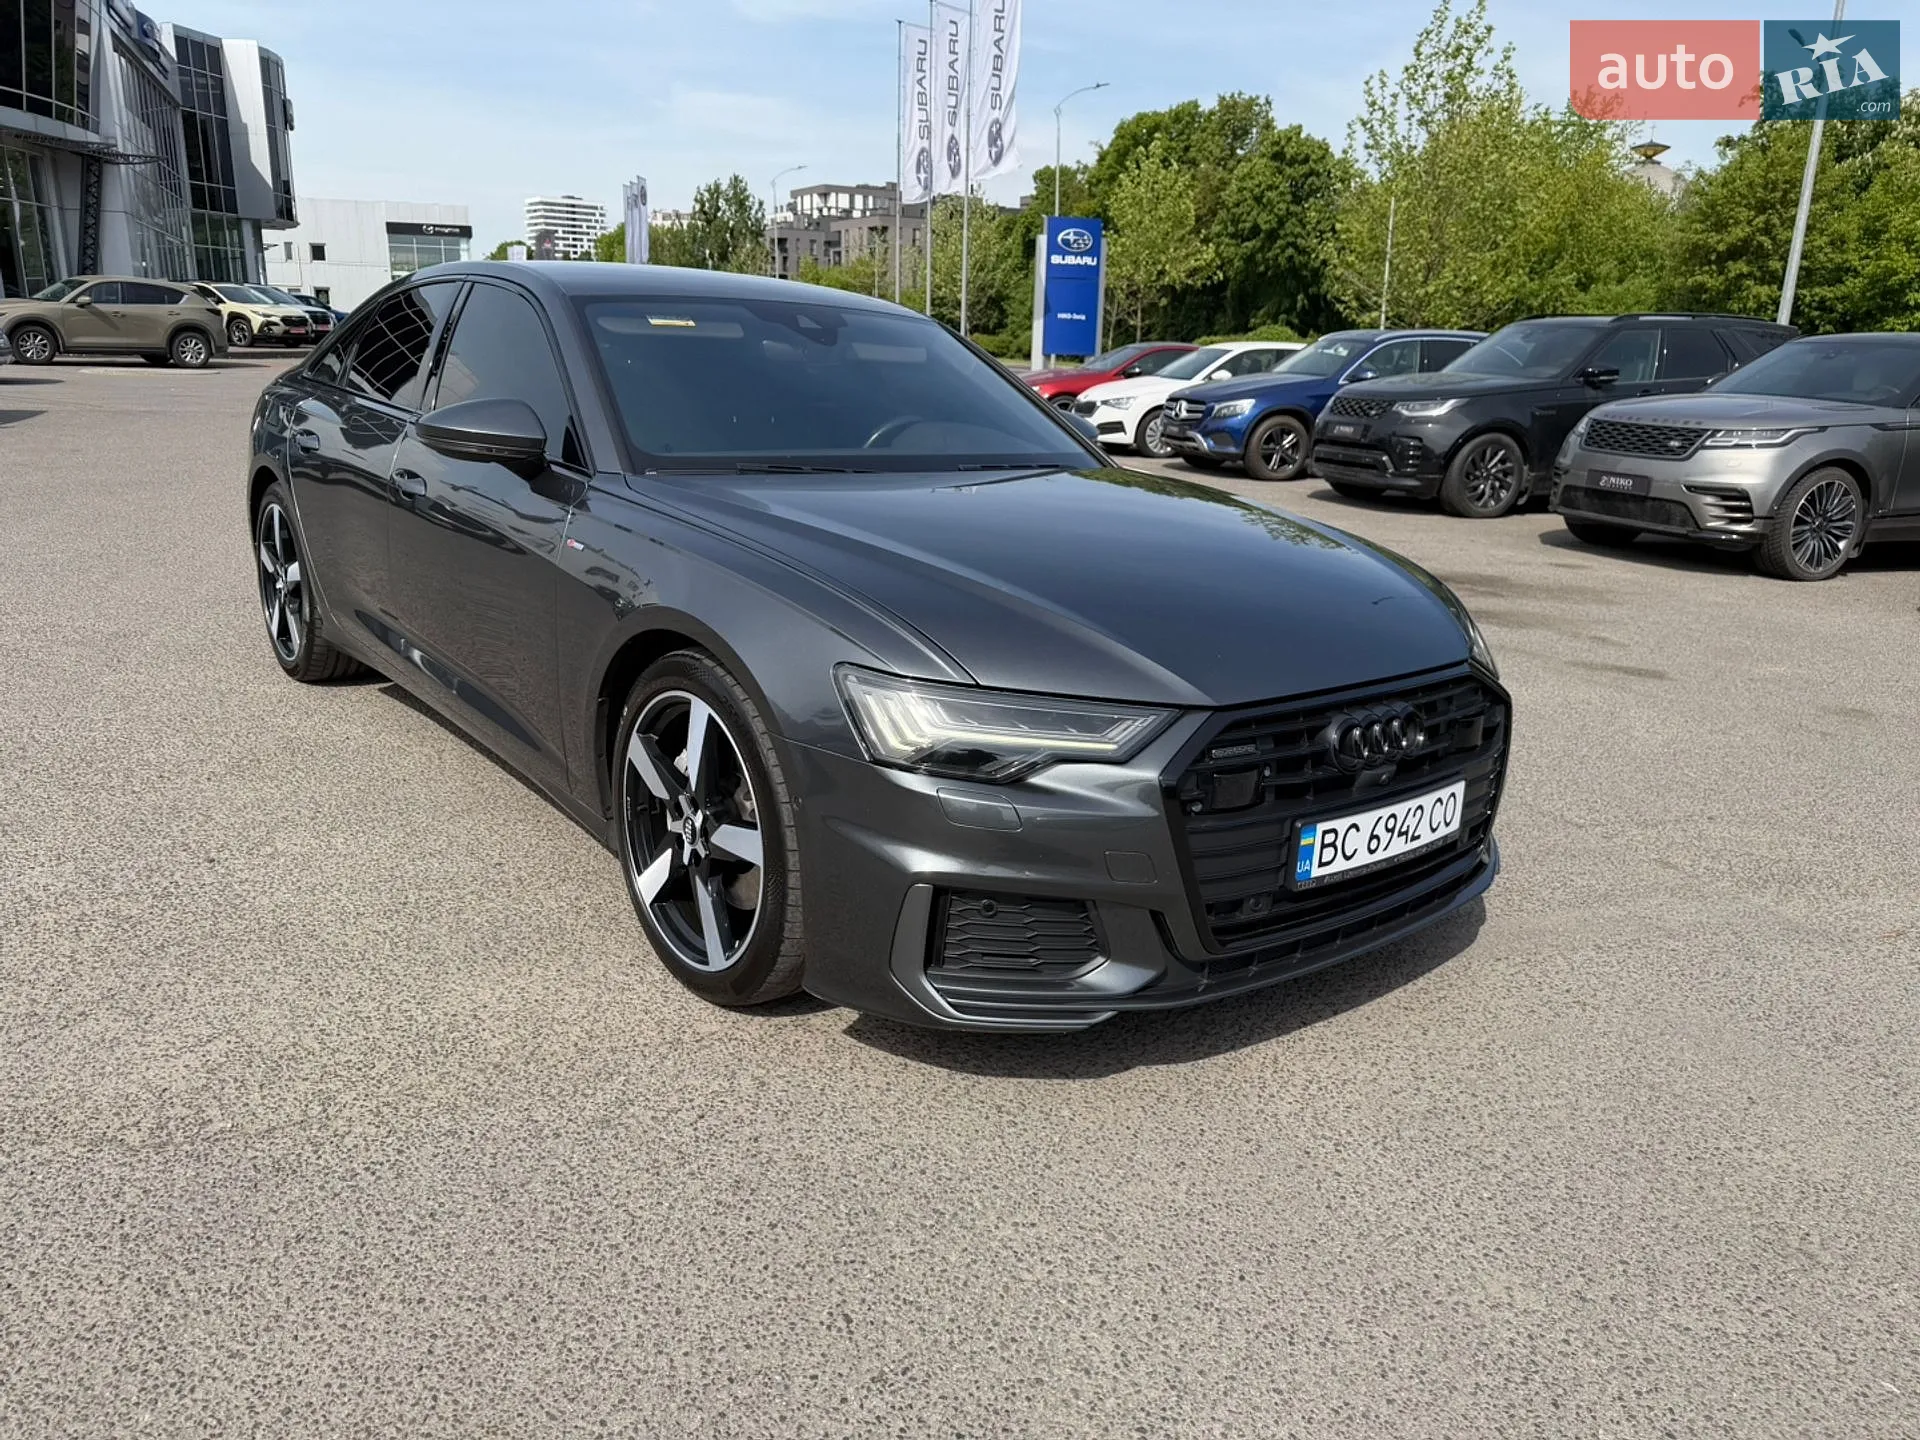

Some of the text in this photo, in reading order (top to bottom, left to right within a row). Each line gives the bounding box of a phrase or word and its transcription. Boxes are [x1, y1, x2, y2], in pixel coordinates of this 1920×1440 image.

[916, 38, 930, 141] SUBARU
[947, 19, 959, 128] SUBARU
[1050, 254, 1098, 266] SUBARU
[1609, 475, 1634, 487] NIKO
[1317, 822, 1361, 868] BC
[1366, 804, 1424, 855] 6942
[1428, 791, 1457, 834] CO
[1297, 860, 1311, 873] UA
